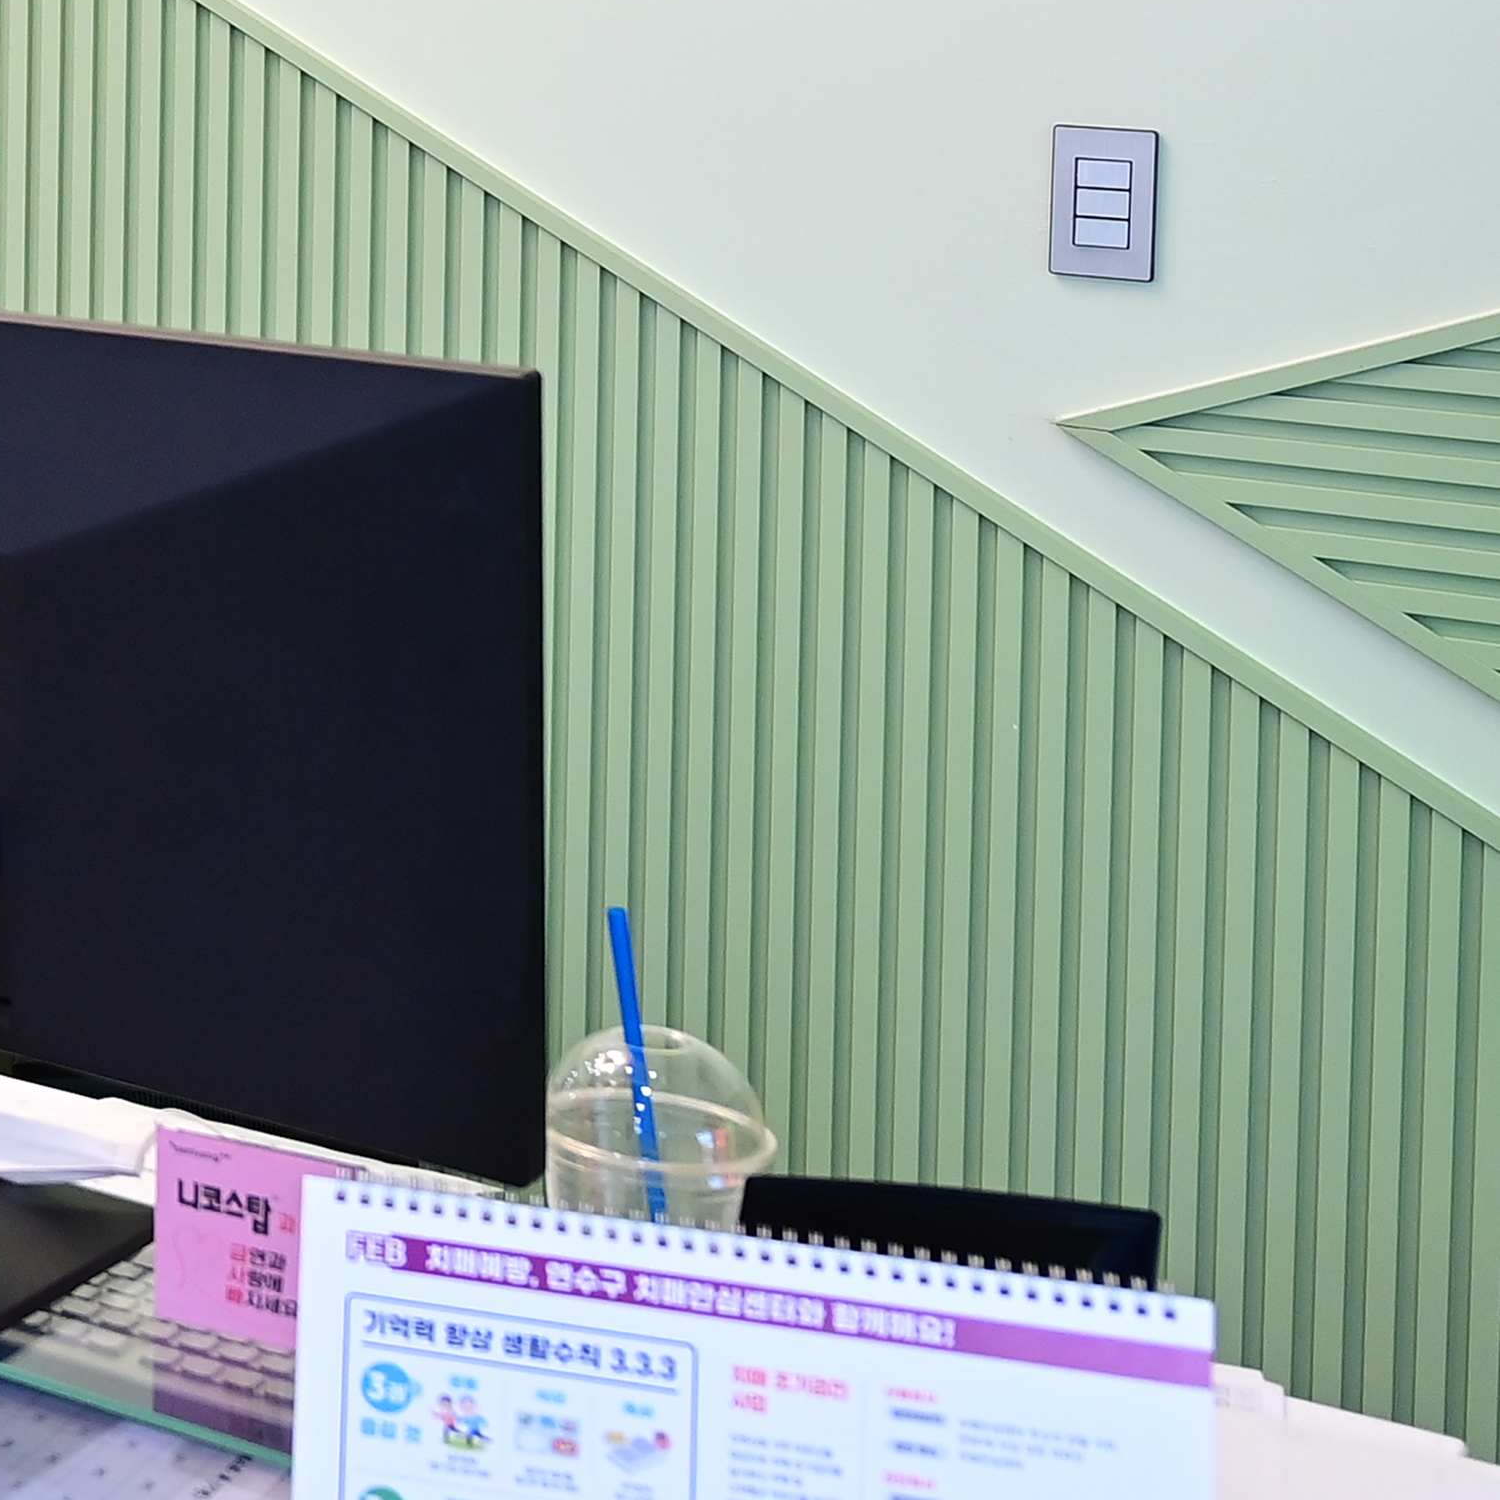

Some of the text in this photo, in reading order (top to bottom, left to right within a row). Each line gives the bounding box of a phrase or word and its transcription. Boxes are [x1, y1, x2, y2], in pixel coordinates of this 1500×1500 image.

[178, 1178, 271, 1235] 니코스탑
[346, 1230, 407, 1268] FEB
[610, 1347, 678, 1382] 3.3.3
